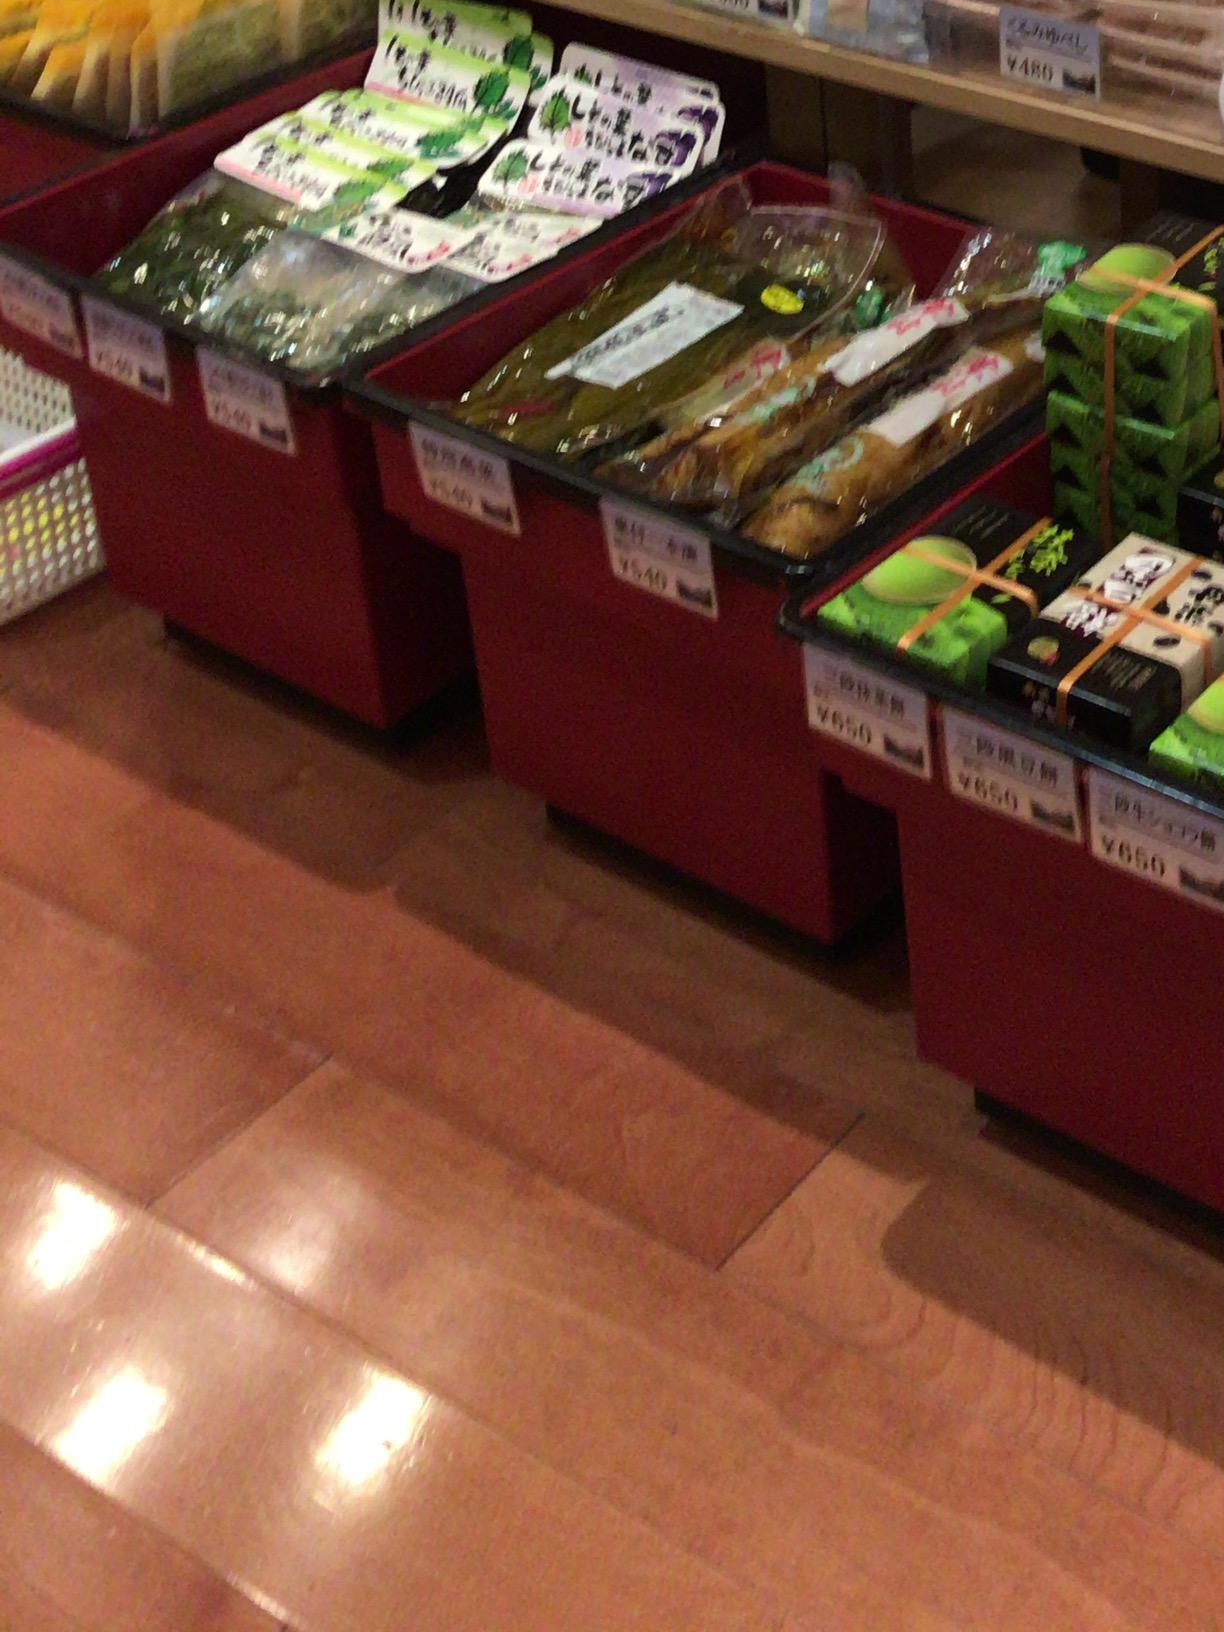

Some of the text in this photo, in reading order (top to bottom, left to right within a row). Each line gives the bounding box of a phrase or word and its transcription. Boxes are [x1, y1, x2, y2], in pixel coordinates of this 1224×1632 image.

[1006, 52, 1053, 83] ¥480
[815, 706, 873, 746] ¥650
[957, 771, 1020, 812] ¥650
[1100, 835, 1167, 879] ¥650
